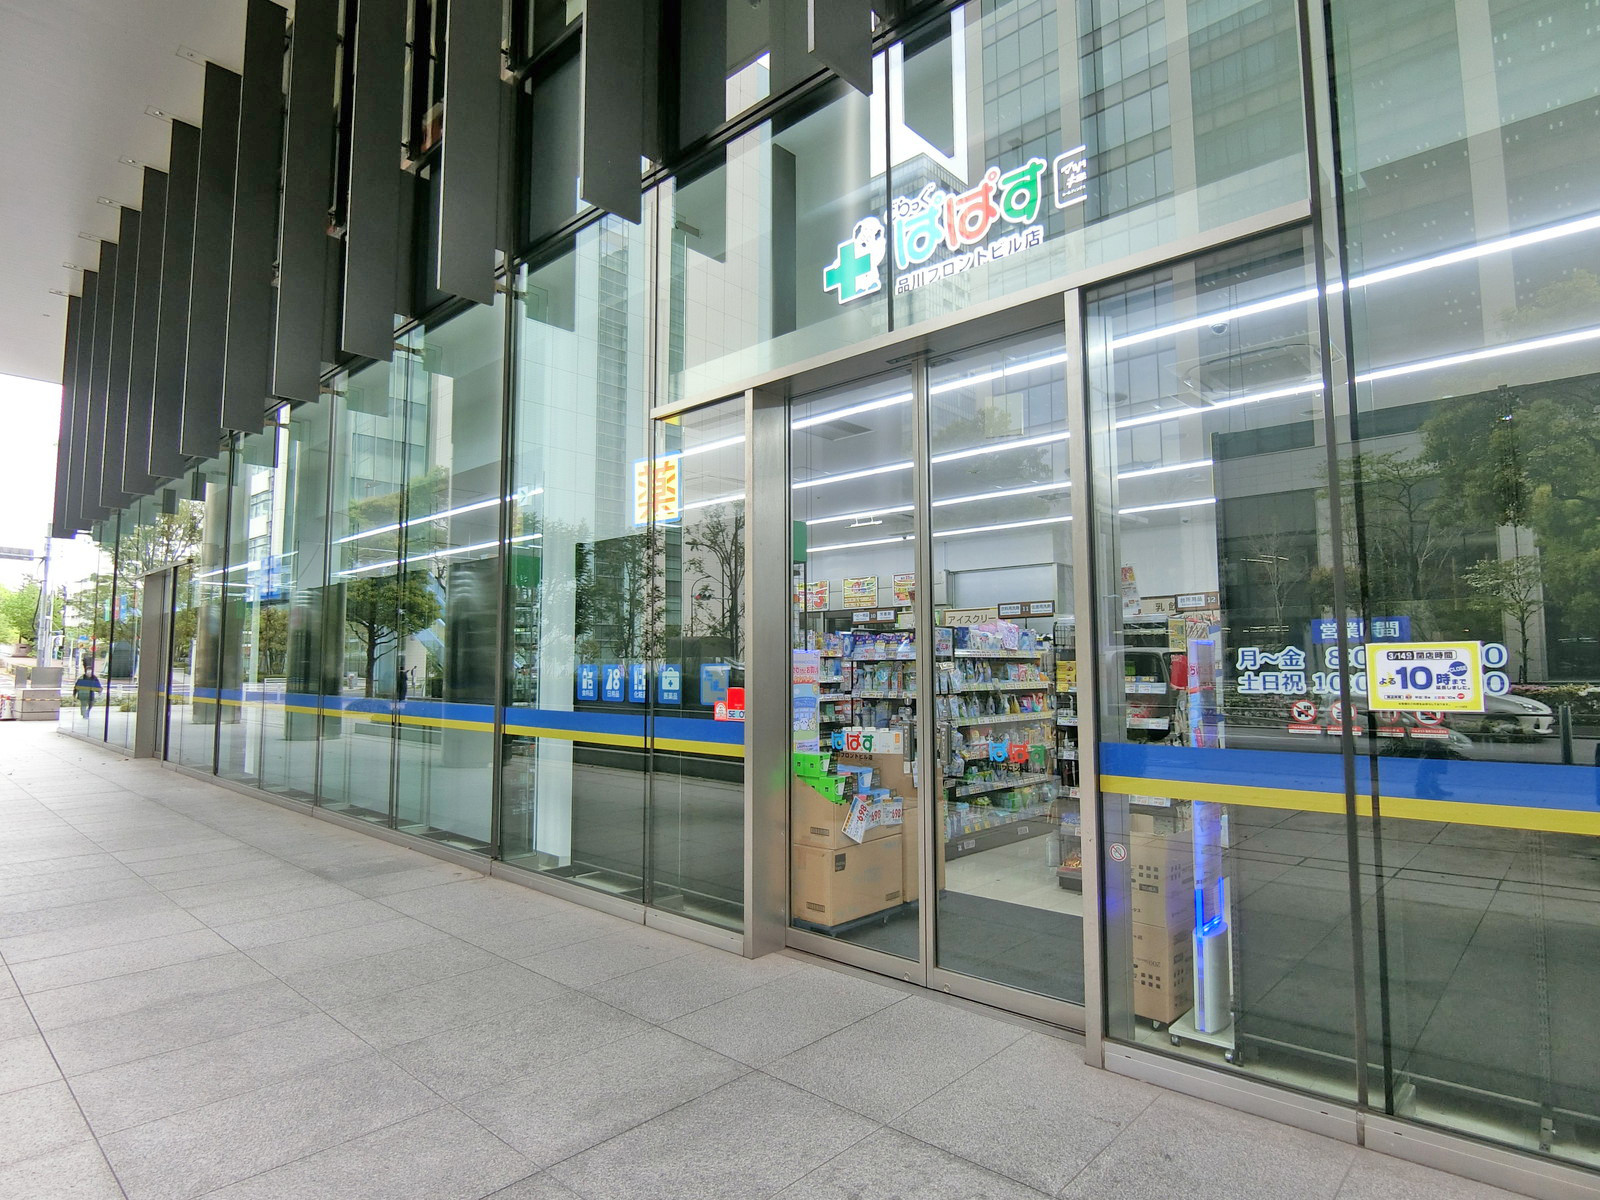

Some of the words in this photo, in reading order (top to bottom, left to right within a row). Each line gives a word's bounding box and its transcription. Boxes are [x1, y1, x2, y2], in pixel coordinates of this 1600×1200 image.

[897, 229, 1042, 293] 品川フロントビル店
[1320, 621, 1400, 639] 営業時間
[1239, 673, 1304, 693] 土日祝
[607, 690, 620, 698] 日用品
[728, 710, 746, 718] SECO
[857, 804, 868, 822] 698
